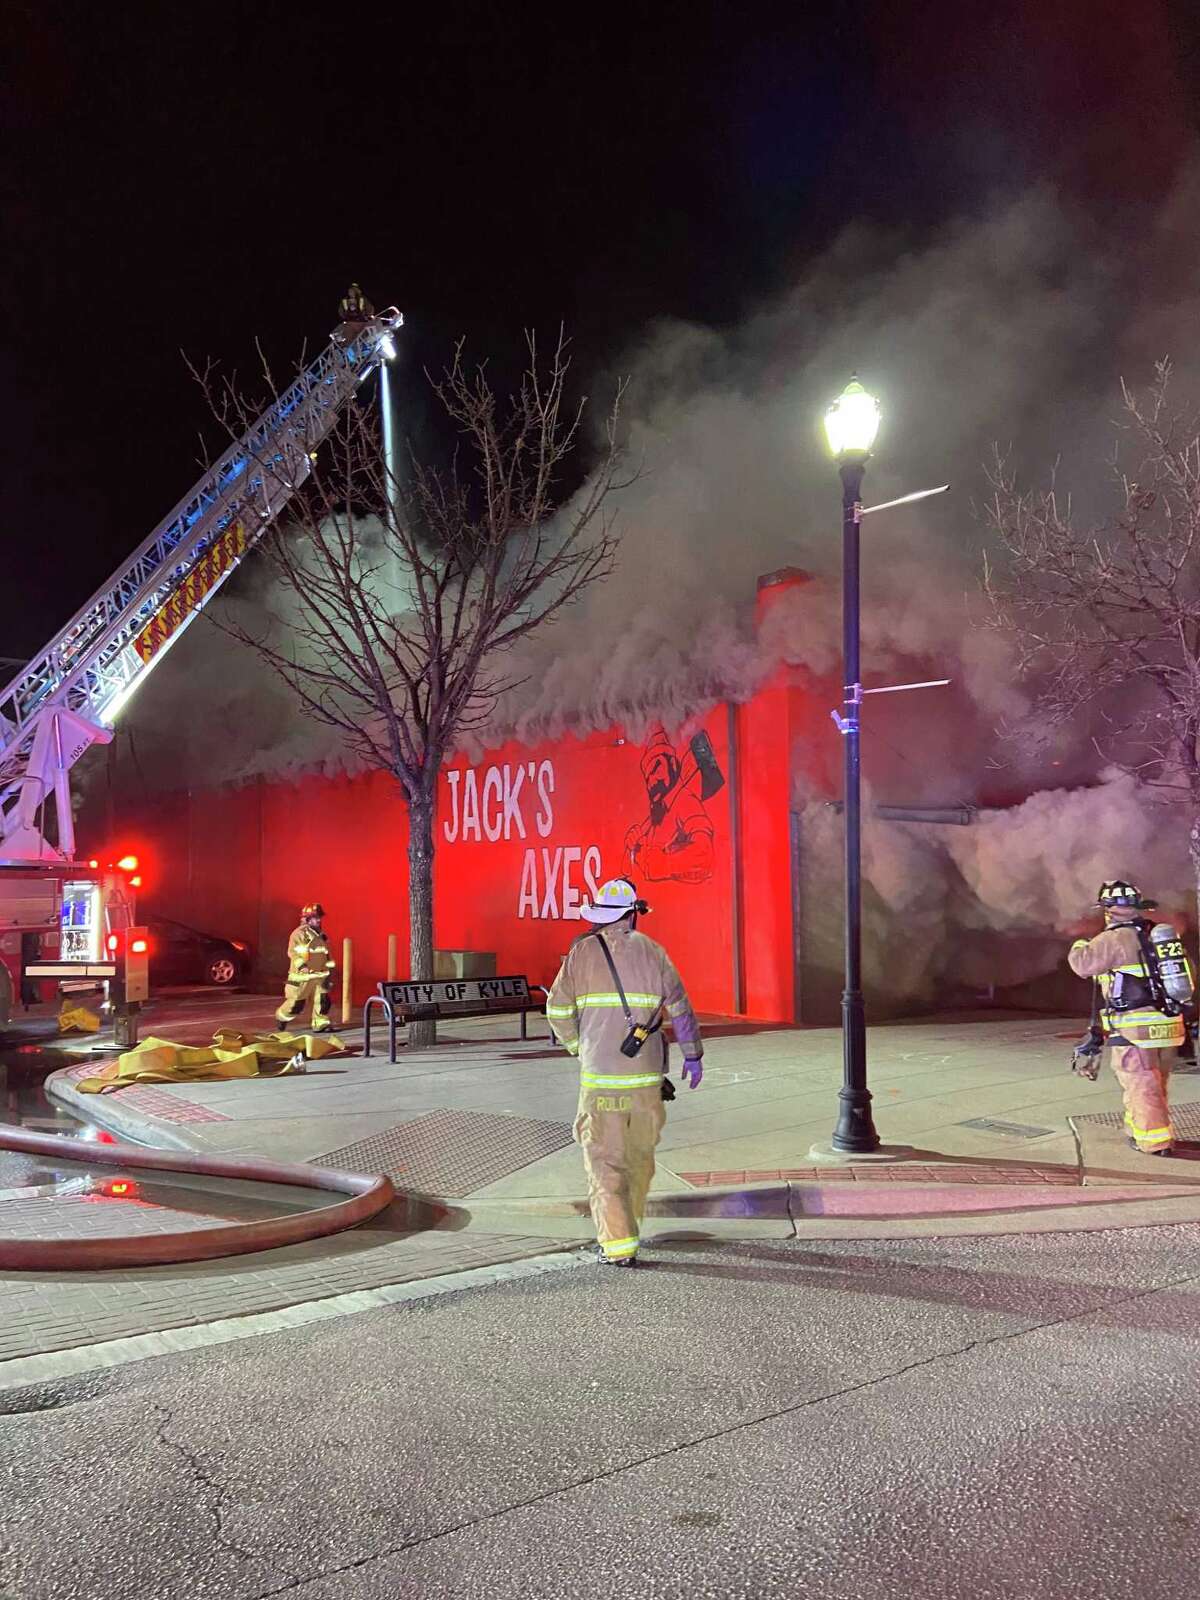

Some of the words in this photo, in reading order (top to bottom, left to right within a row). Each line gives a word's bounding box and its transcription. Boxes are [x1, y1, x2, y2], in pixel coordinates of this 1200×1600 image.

[70, 744, 84, 760] 105
[443, 759, 555, 842] JACK'S
[518, 846, 601, 920] AXES
[1156, 942, 1184, 958] E-23
[391, 985, 433, 1004] CITY
[445, 983, 467, 1000] OF
[478, 980, 524, 999] KYLE
